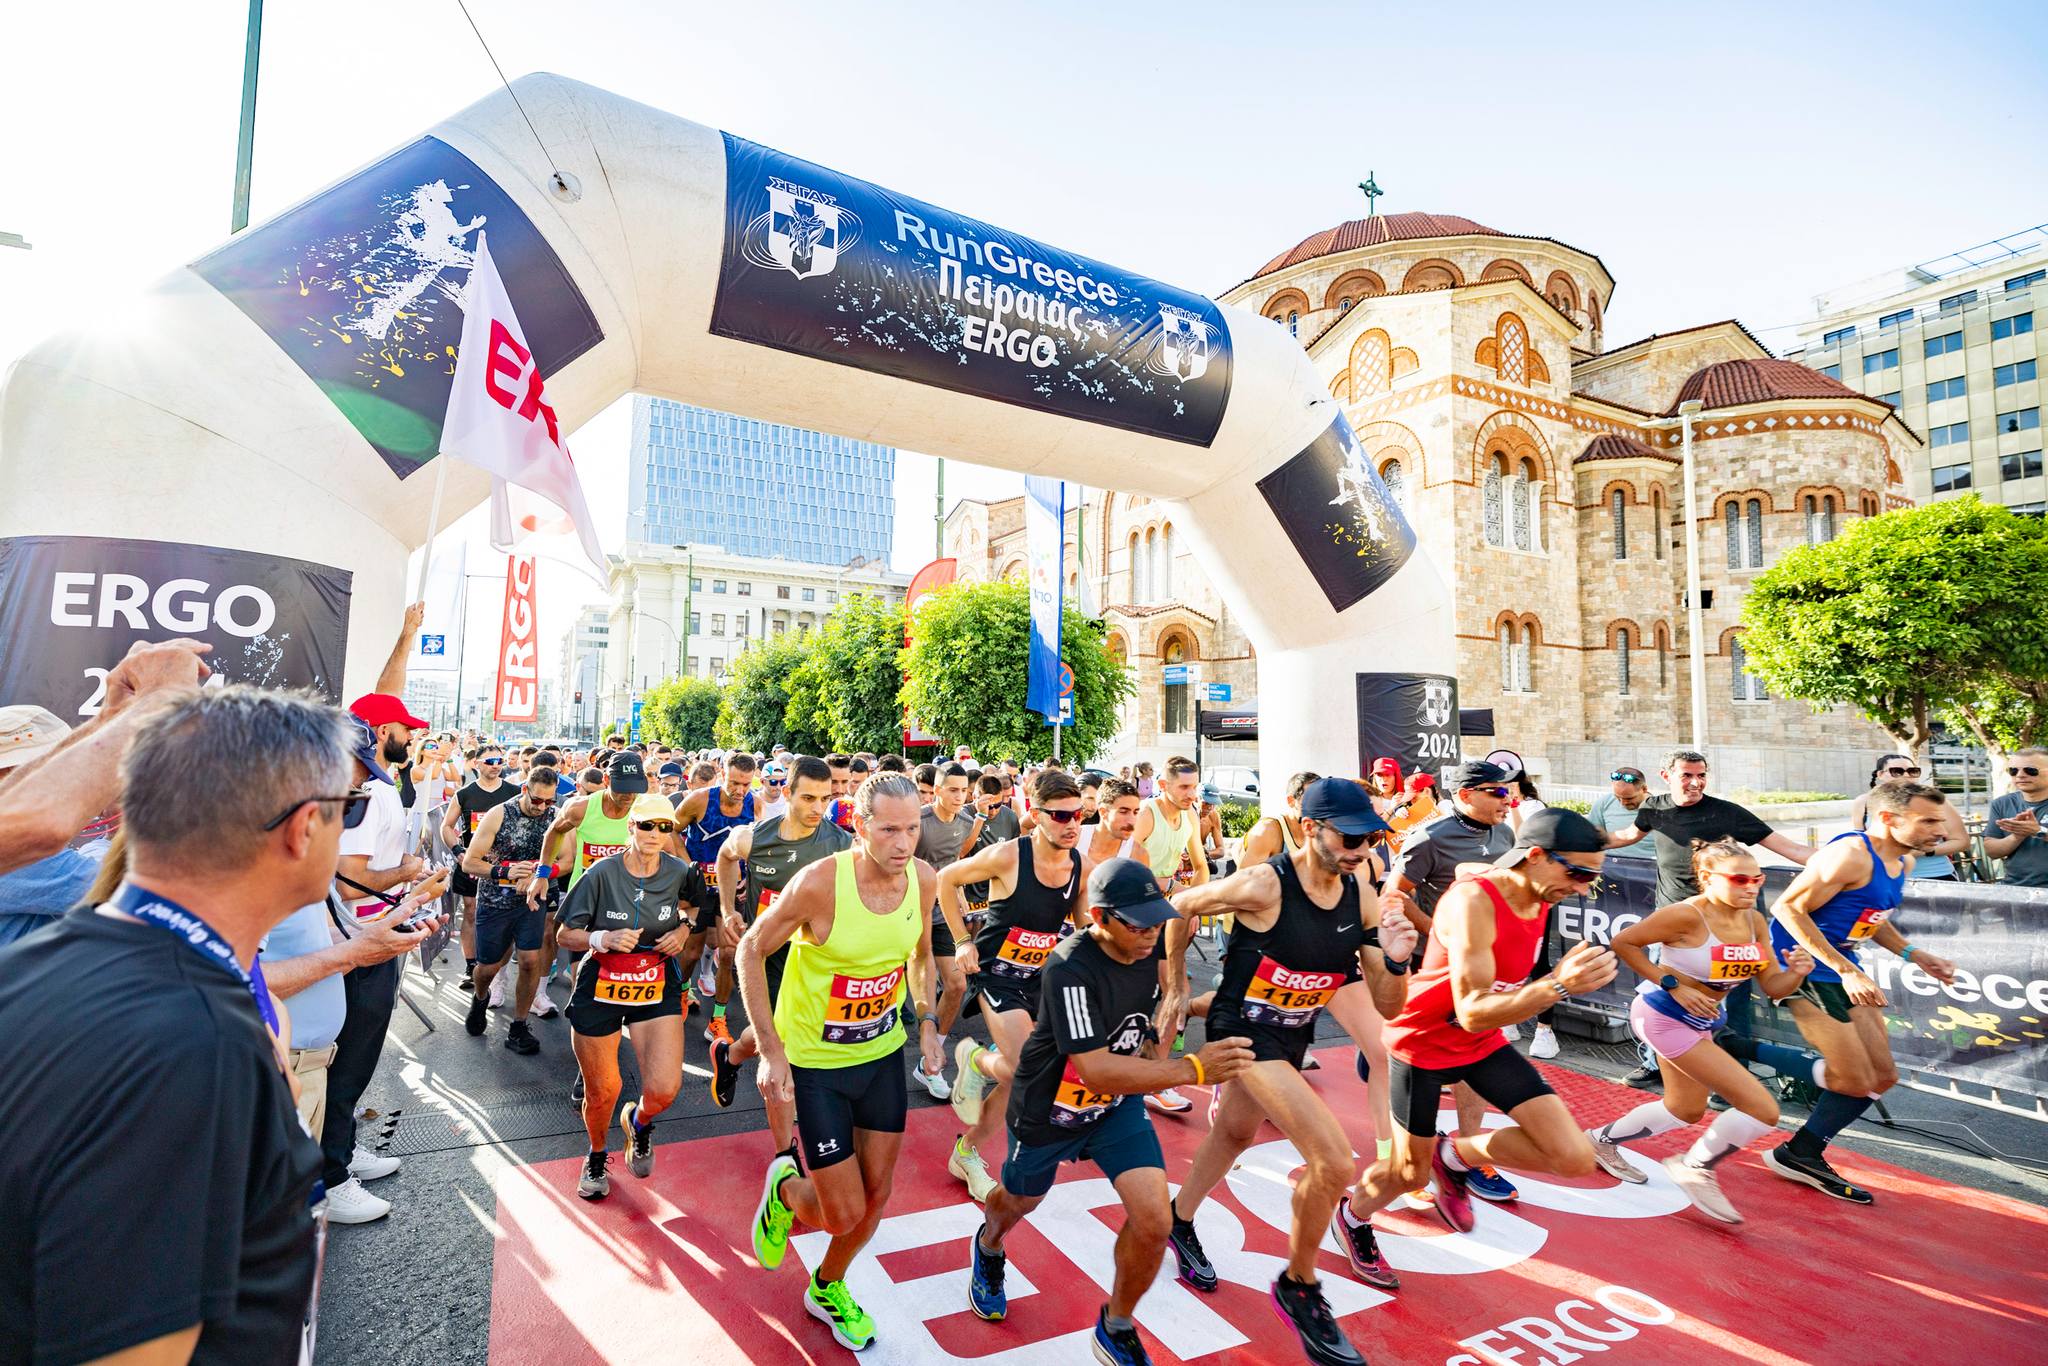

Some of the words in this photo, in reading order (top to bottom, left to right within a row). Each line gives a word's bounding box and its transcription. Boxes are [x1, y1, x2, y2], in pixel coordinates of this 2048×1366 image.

[894, 209, 1118, 307] RunGreece
[963, 315, 1057, 368] ERGO
[51, 572, 276, 637] ERGO
[1417, 732, 1457, 759] 2024
[606, 910, 629, 920] ERGO
[1723, 945, 1760, 961] ERGO
[1271, 967, 1333, 990] ERGO
[1720, 964, 1763, 977] 1395
[606, 984, 656, 1001] 1676
[845, 971, 898, 998] ERGO
